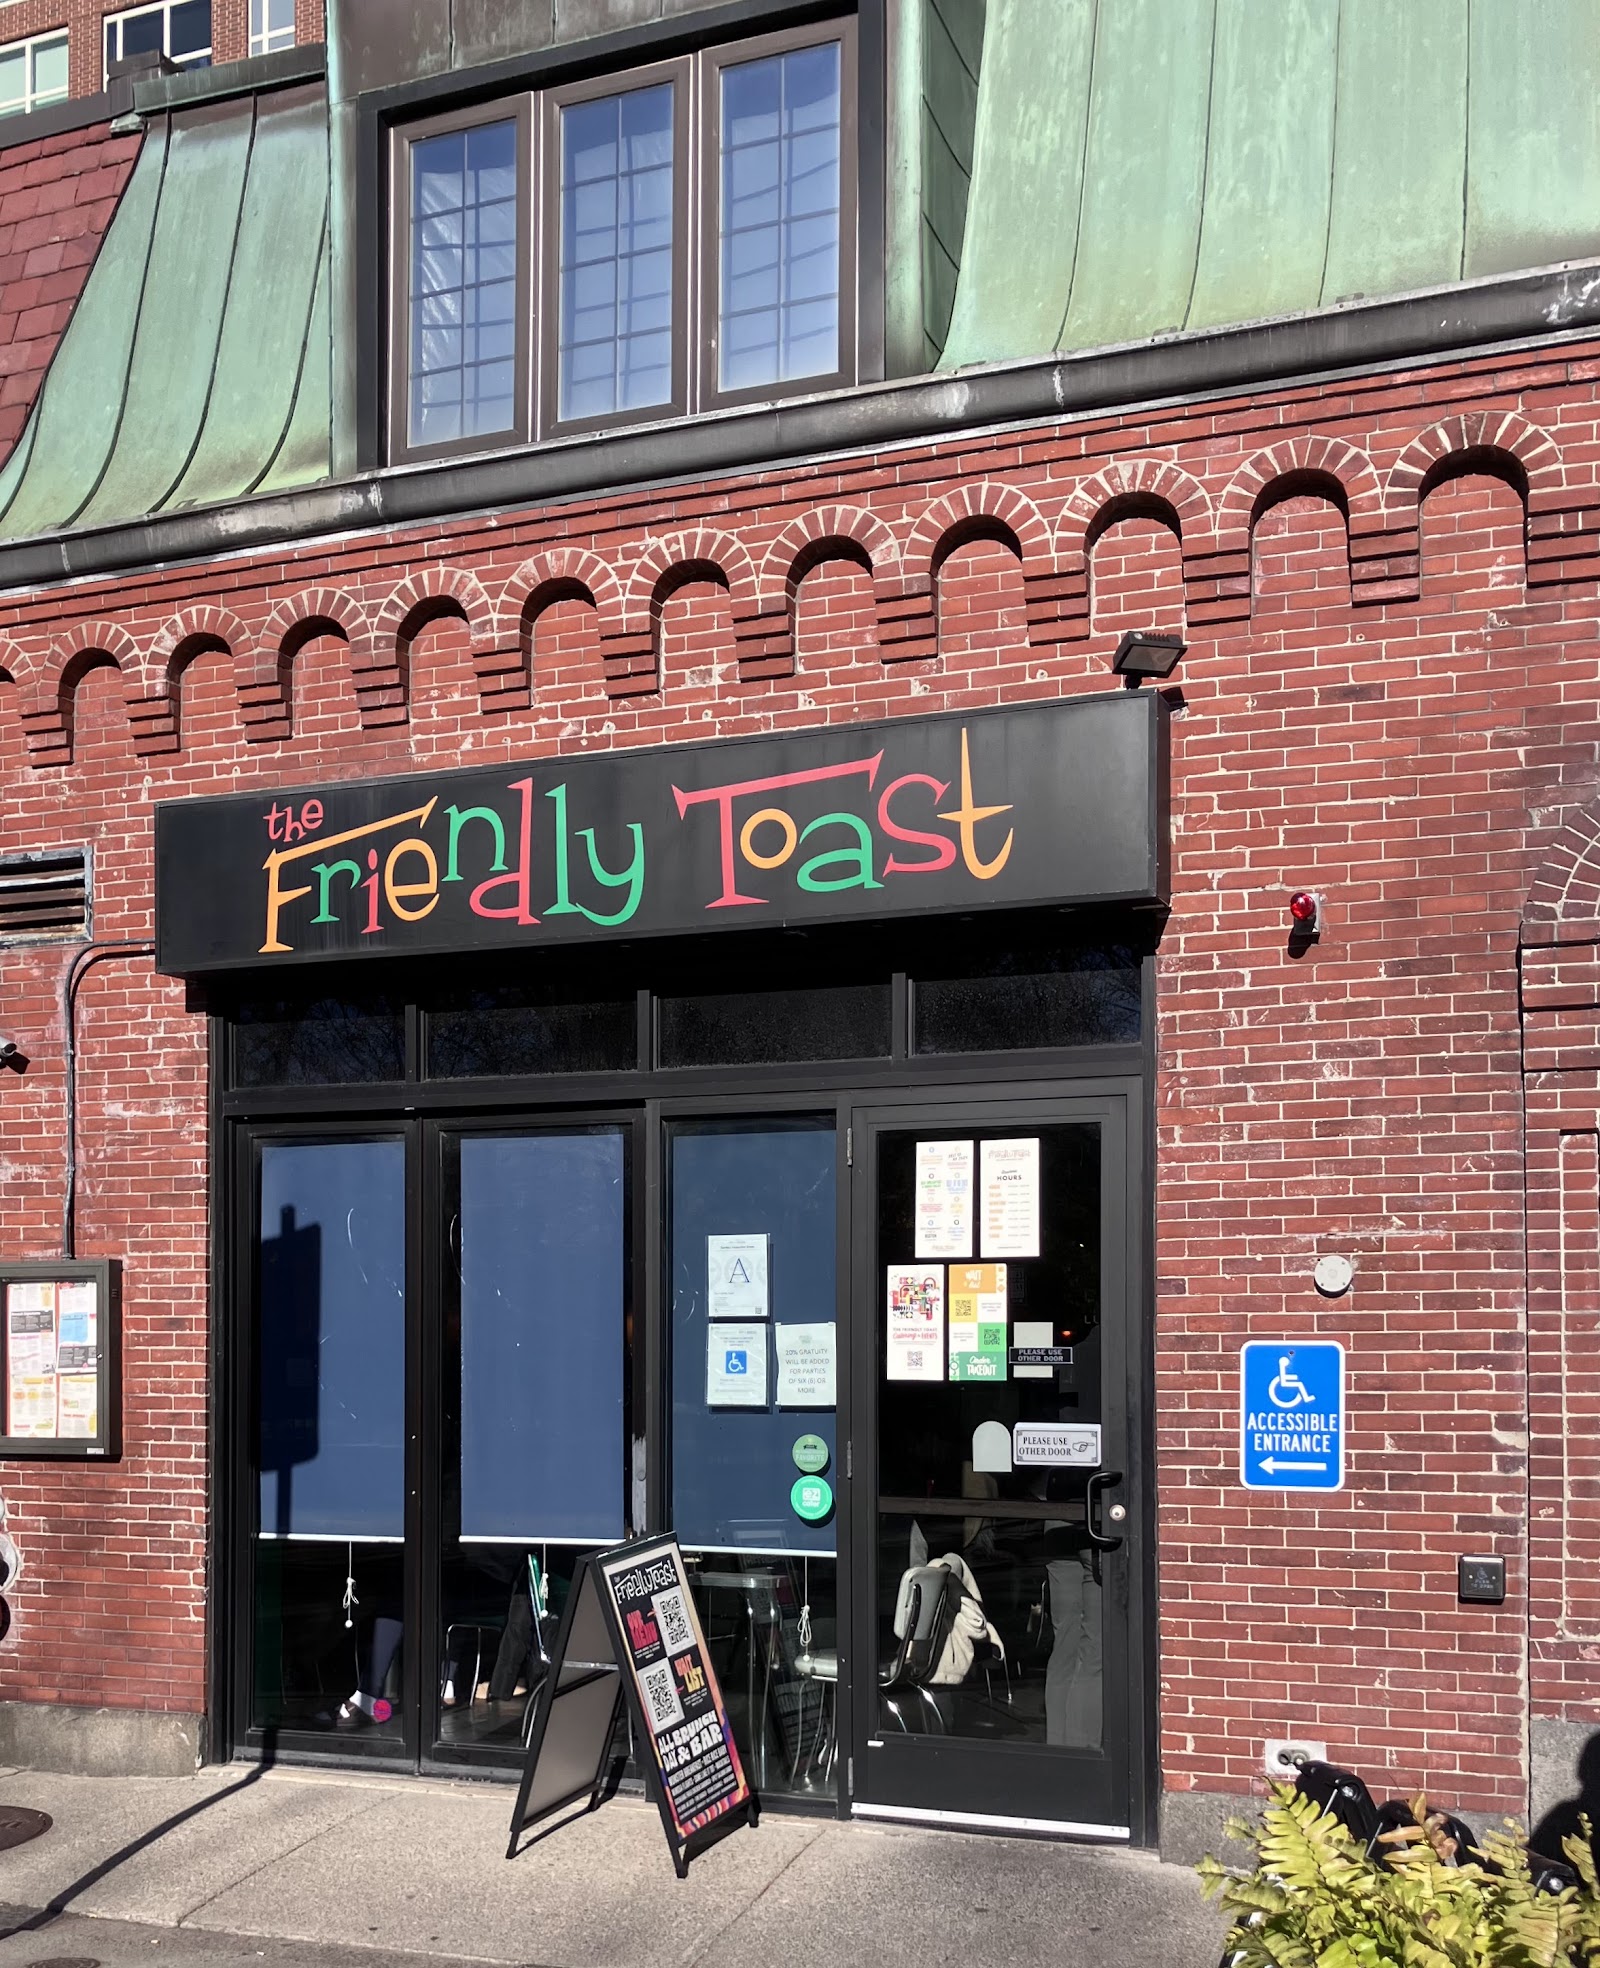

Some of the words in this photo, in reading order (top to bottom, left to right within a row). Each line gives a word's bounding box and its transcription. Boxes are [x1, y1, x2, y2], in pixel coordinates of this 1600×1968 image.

[263, 798, 323, 843] the
[257, 777, 645, 953] Friendly
[671, 726, 1014, 909] Toast
[728, 1258, 751, 1284] A
[966, 1364, 998, 1376] TAKEOUT
[1247, 1412, 1338, 1432] ACCESSIBLE
[1018, 1447, 1048, 1456] OTHER
[1048, 1447, 1072, 1456] DOOR
[1023, 1436, 1050, 1445] PLEASE
[1053, 1437, 1068, 1445] USE
[1254, 1433, 1332, 1453] ENTRANCE
[614, 1568, 653, 1605] Friendly
[645, 1559, 677, 1589] Toast
[630, 1621, 658, 1650] MENU
[674, 1653, 693, 1677] WAIT
[684, 1665, 705, 1693] LIST
[658, 1733, 674, 1756] ALL
[672, 1709, 718, 1748] BRUNCH
[662, 1749, 679, 1772] DAY
[677, 1745, 691, 1765] &
[689, 1723, 723, 1757] BAR
